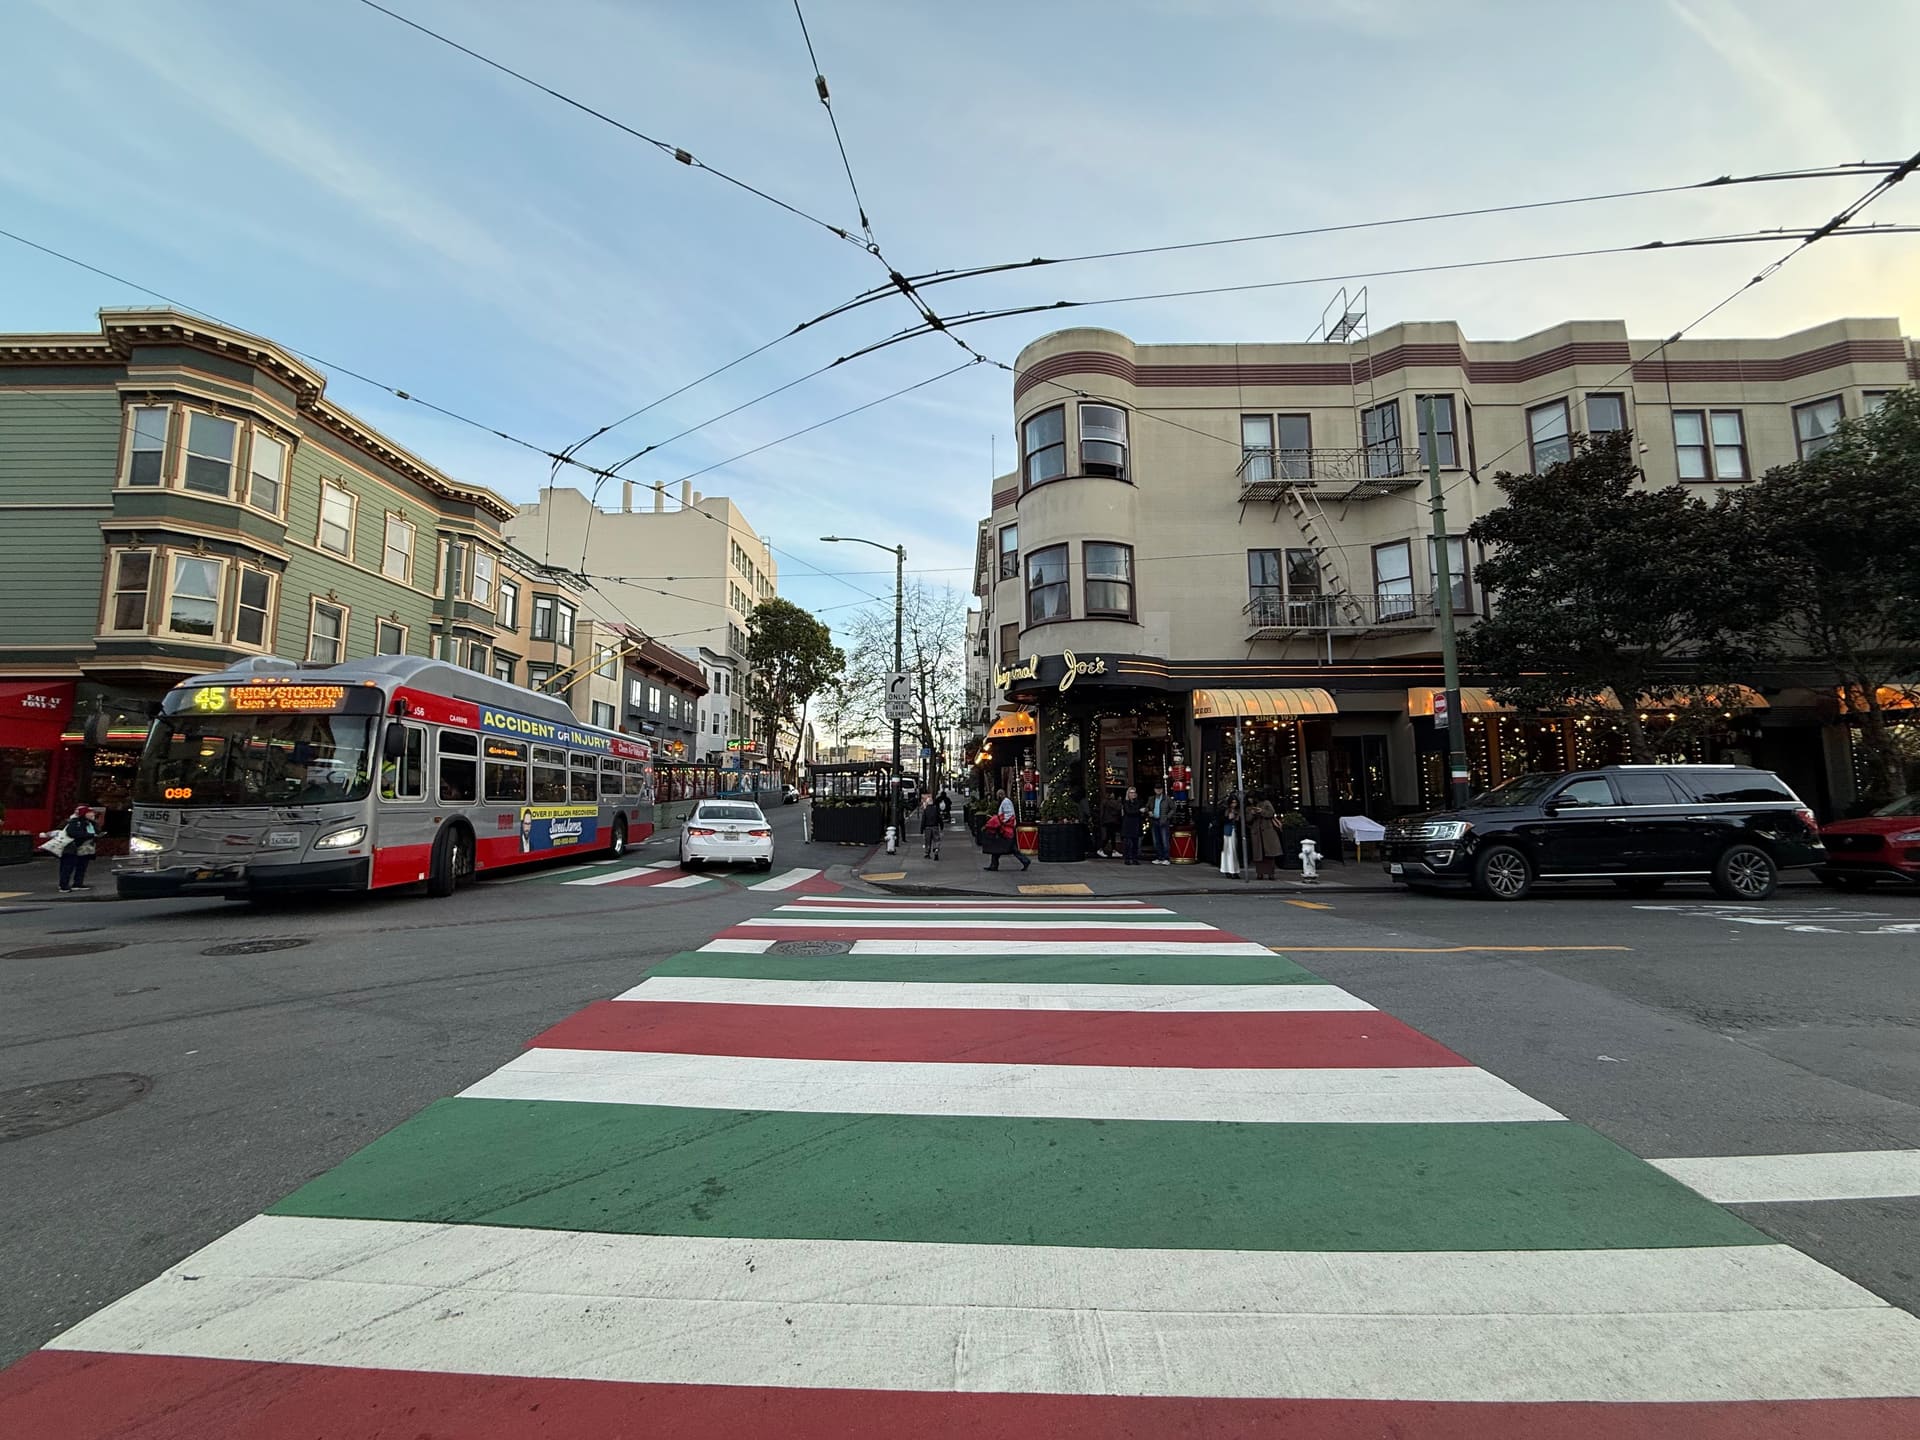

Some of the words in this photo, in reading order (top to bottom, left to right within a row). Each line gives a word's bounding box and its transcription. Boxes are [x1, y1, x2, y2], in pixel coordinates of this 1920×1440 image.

[1059, 649, 1108, 692] Joe's
[27, 694, 47, 702] EAT
[194, 687, 226, 710] 45
[229, 686, 344, 700] UNION/STOCKTON
[21, 700, 57, 709] TONY'S
[236, 699, 265, 709] Lyon
[279, 698, 337, 709] Greenwich
[483, 711, 555, 738] ACCIDENT
[557, 731, 570, 742] OR
[571, 731, 611, 750] INJURY?
[1015, 725, 1034, 733] JOE'S
[164, 787, 193, 799] 098
[142, 810, 171, 821] 5856
[532, 810, 548, 818] OVER
